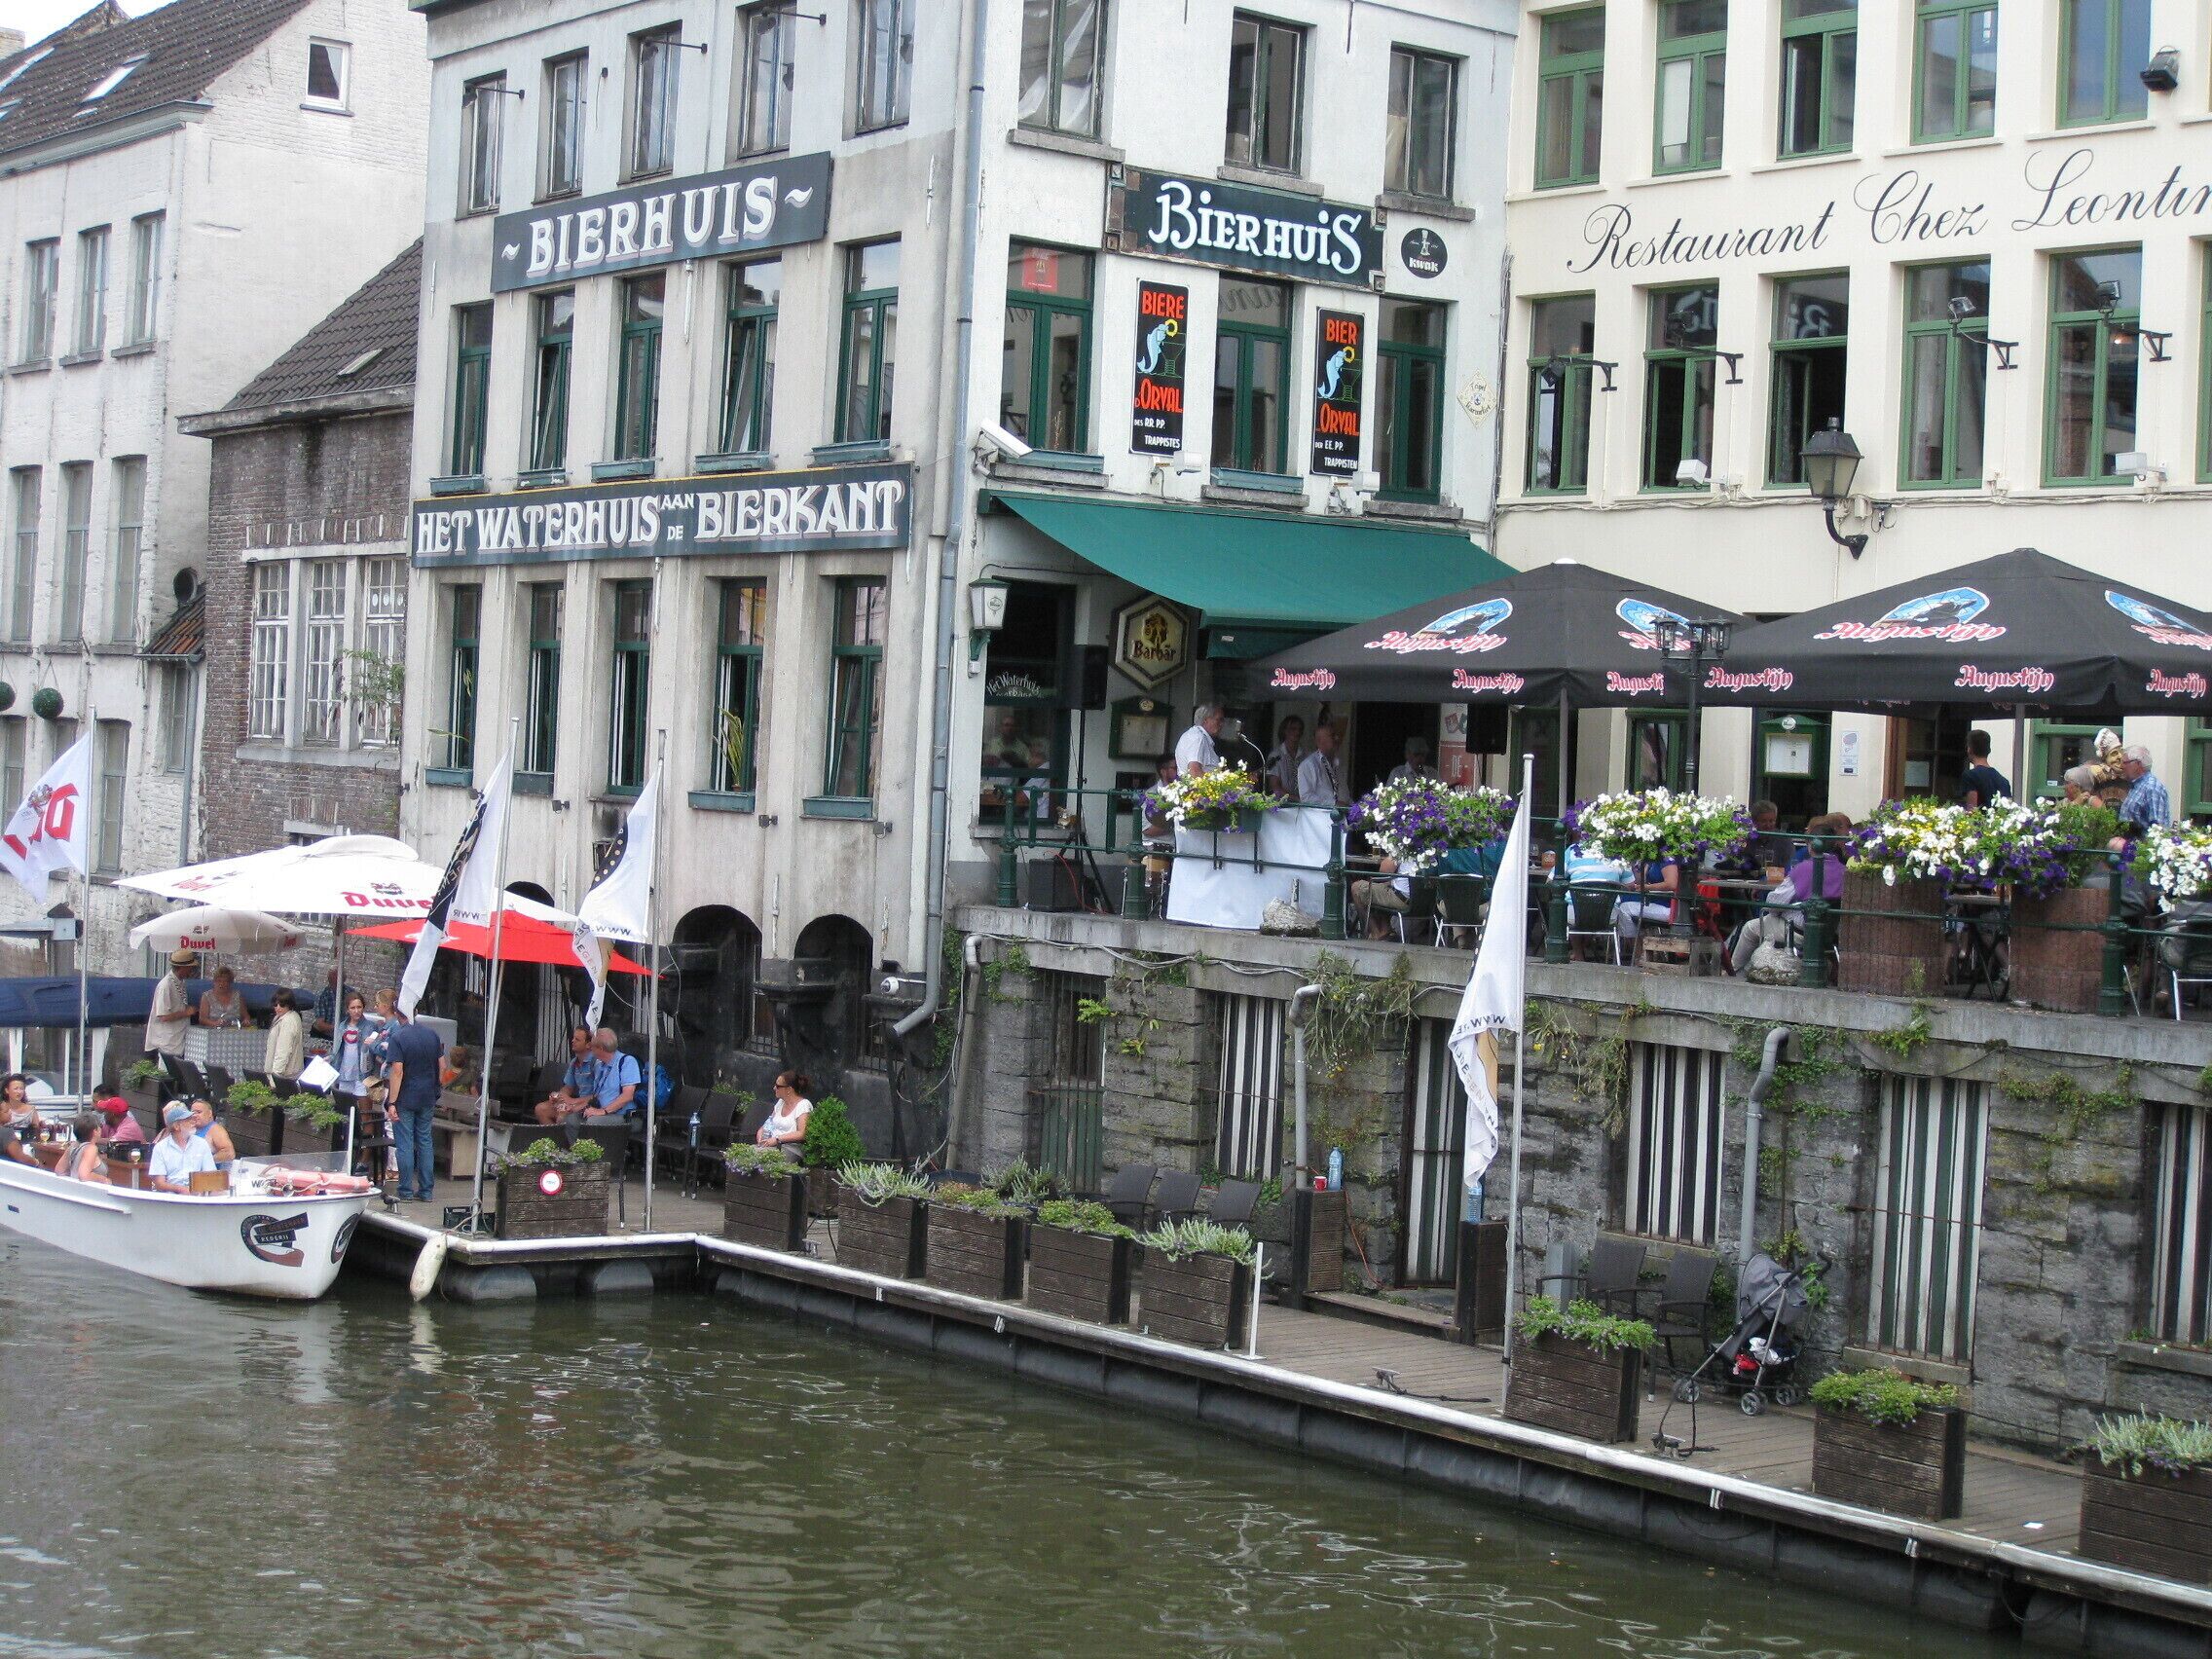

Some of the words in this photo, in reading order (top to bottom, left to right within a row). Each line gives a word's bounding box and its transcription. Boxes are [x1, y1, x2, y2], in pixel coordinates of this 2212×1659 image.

[526, 175, 779, 278] BIERHUIS
[1567, 201, 1835, 274] Restaurant
[1853, 169, 1989, 244] Chez
[1141, 290, 1185, 319] BIERE
[1325, 318, 1359, 346] BIER
[1144, 434, 1181, 449] TRAPPISTES
[1323, 456, 1358, 470] TRAPPISTEN
[660, 493, 694, 511] AAN
[693, 479, 906, 542] BIERKANT
[416, 509, 473, 558] HET
[476, 493, 662, 554] WATERHUIS
[666, 524, 684, 541] DE
[1271, 667, 1337, 690] Augustijn
[1452, 668, 1525, 694] Augustijn
[1703, 666, 1793, 692] Augustijn
[1954, 664, 2054, 693] Augustijn
[2146, 669, 2208, 699] Augustijn
[179, 935, 216, 950] Duvel
